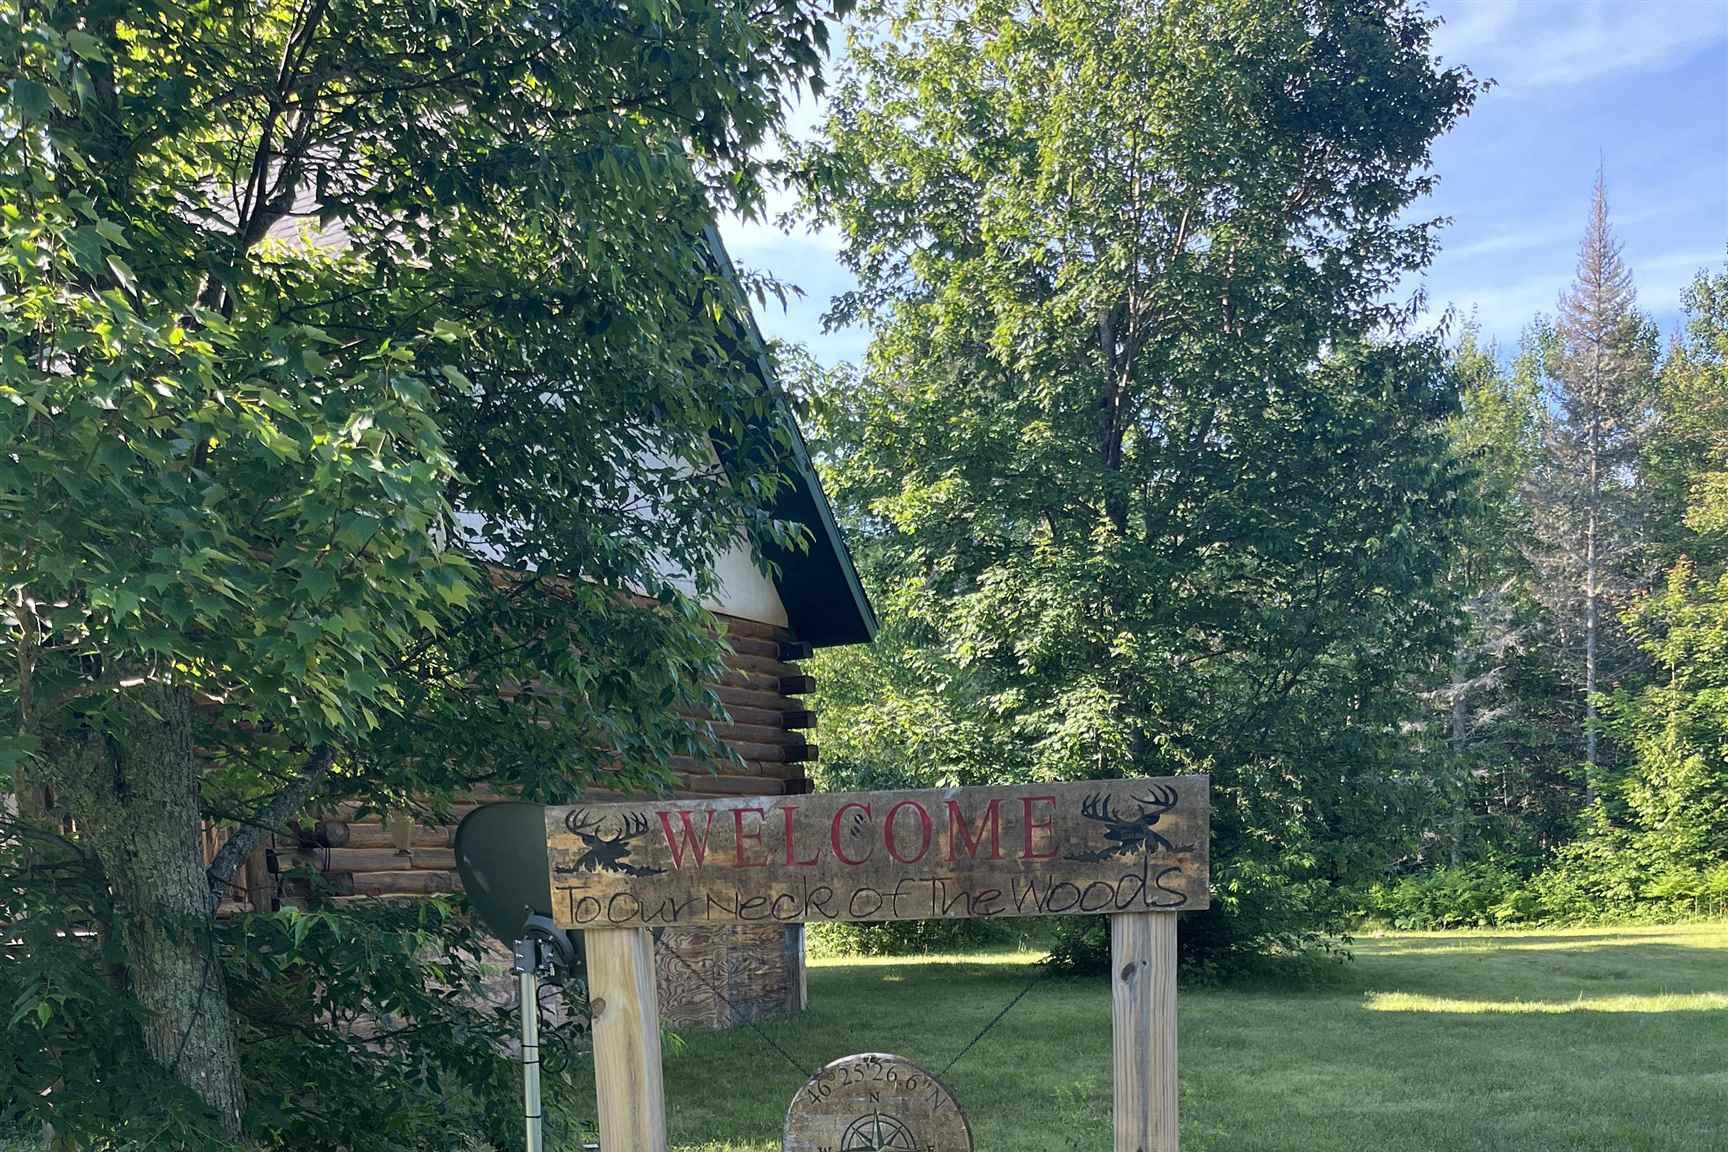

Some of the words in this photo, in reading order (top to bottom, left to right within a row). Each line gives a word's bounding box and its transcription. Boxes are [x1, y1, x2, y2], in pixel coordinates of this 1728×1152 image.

[655, 795, 1057, 872] WELCOME
[555, 885, 601, 924] To
[607, 888, 700, 923] Our
[704, 876, 840, 919] Neck
[849, 878, 915, 918] of
[919, 876, 1006, 916] The
[1011, 854, 1188, 914] Woods
